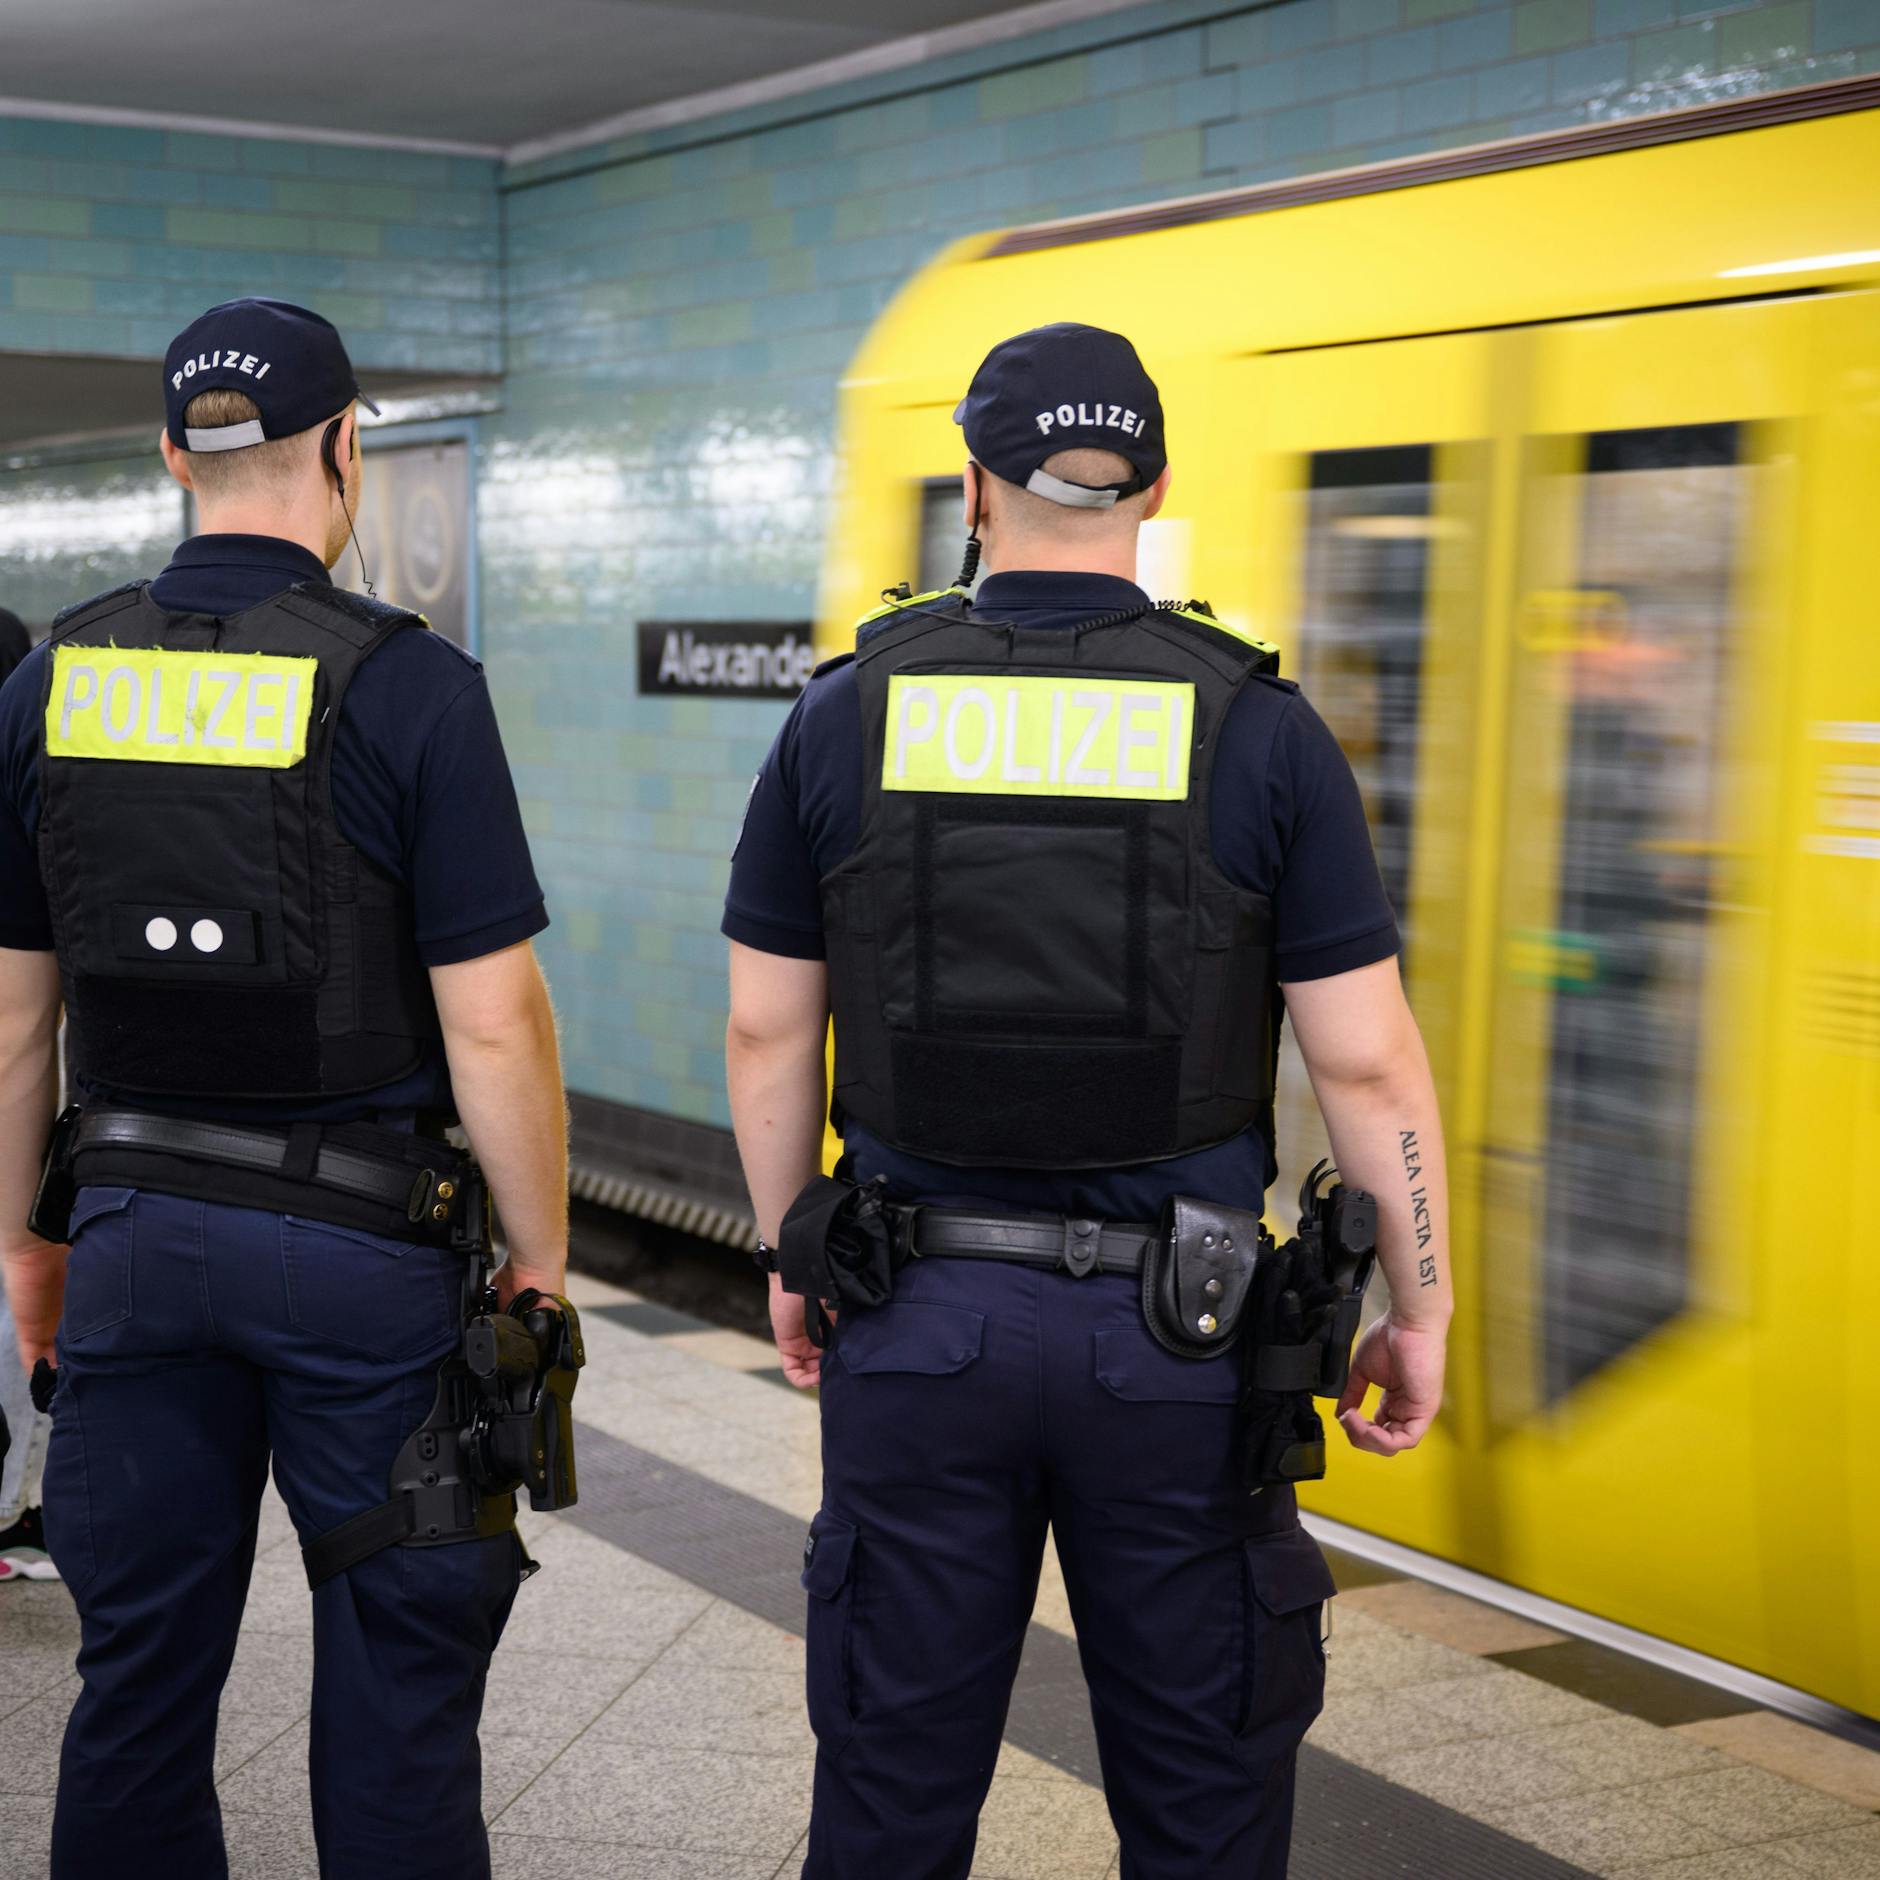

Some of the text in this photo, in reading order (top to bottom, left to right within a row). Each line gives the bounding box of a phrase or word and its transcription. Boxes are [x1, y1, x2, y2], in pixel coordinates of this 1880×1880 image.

[172, 350, 271, 391] POLIZEI
[1036, 403, 1145, 438] POLIZEI
[59, 665, 301, 751] POLIZEI
[893, 685, 1183, 788] POLIZEI
[1400, 1130, 1437, 1287] ALEA IACTA EST
